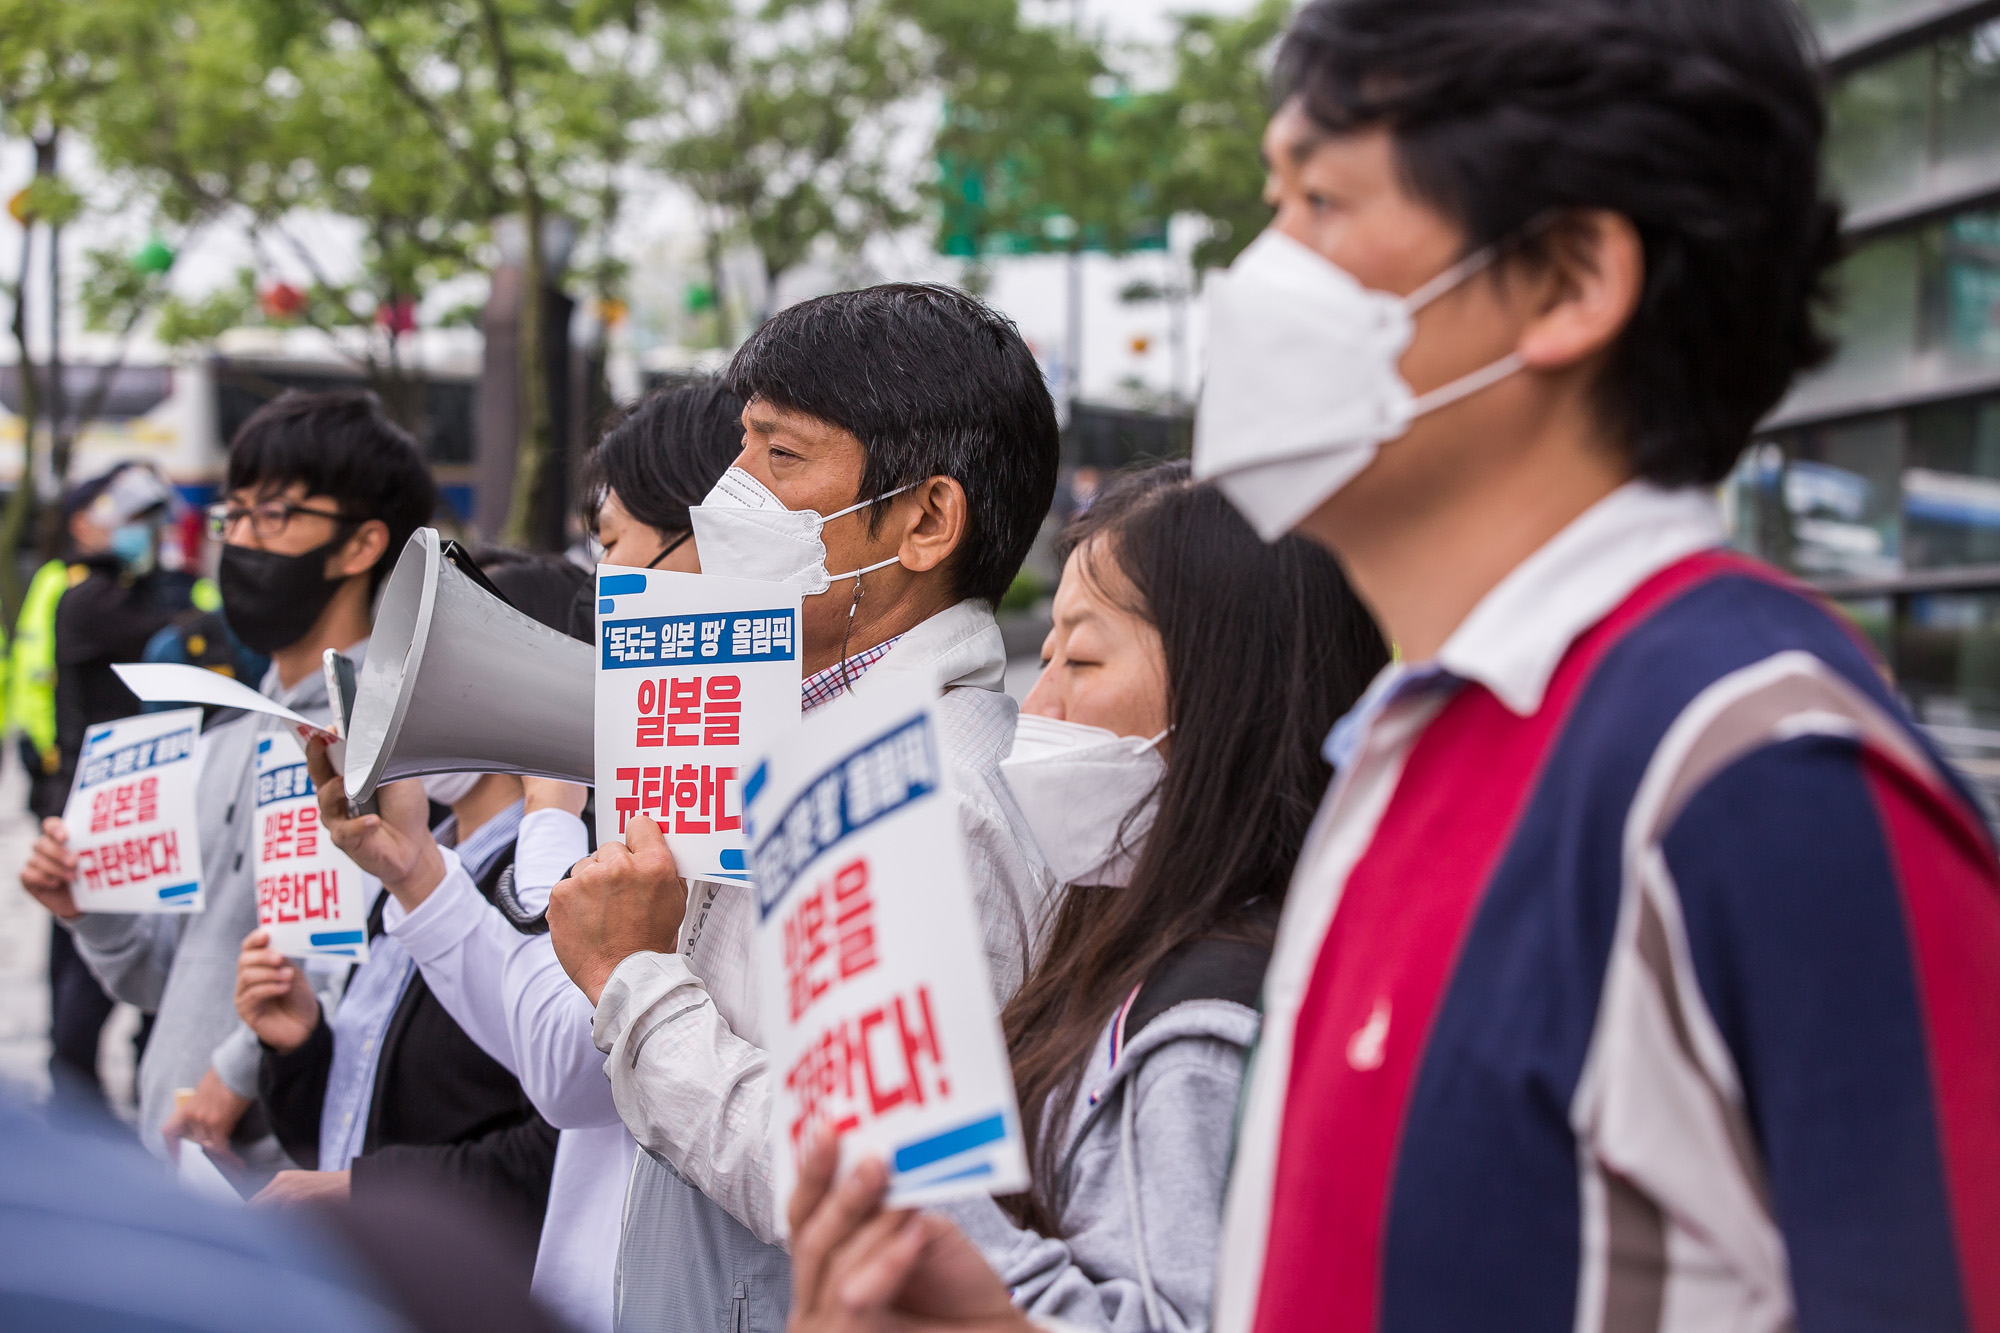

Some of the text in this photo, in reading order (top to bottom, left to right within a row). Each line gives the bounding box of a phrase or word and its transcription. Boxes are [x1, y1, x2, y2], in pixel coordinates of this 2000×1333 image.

[604, 616, 792, 662] '독도는 일본 땅' 올림픽
[636, 675, 742, 748] 일본을
[90, 776, 158, 834] 일본을
[615, 763, 748, 834] 규탄한다
[79, 829, 181, 891] 규탄한다!
[258, 868, 340, 924] 탄한다!
